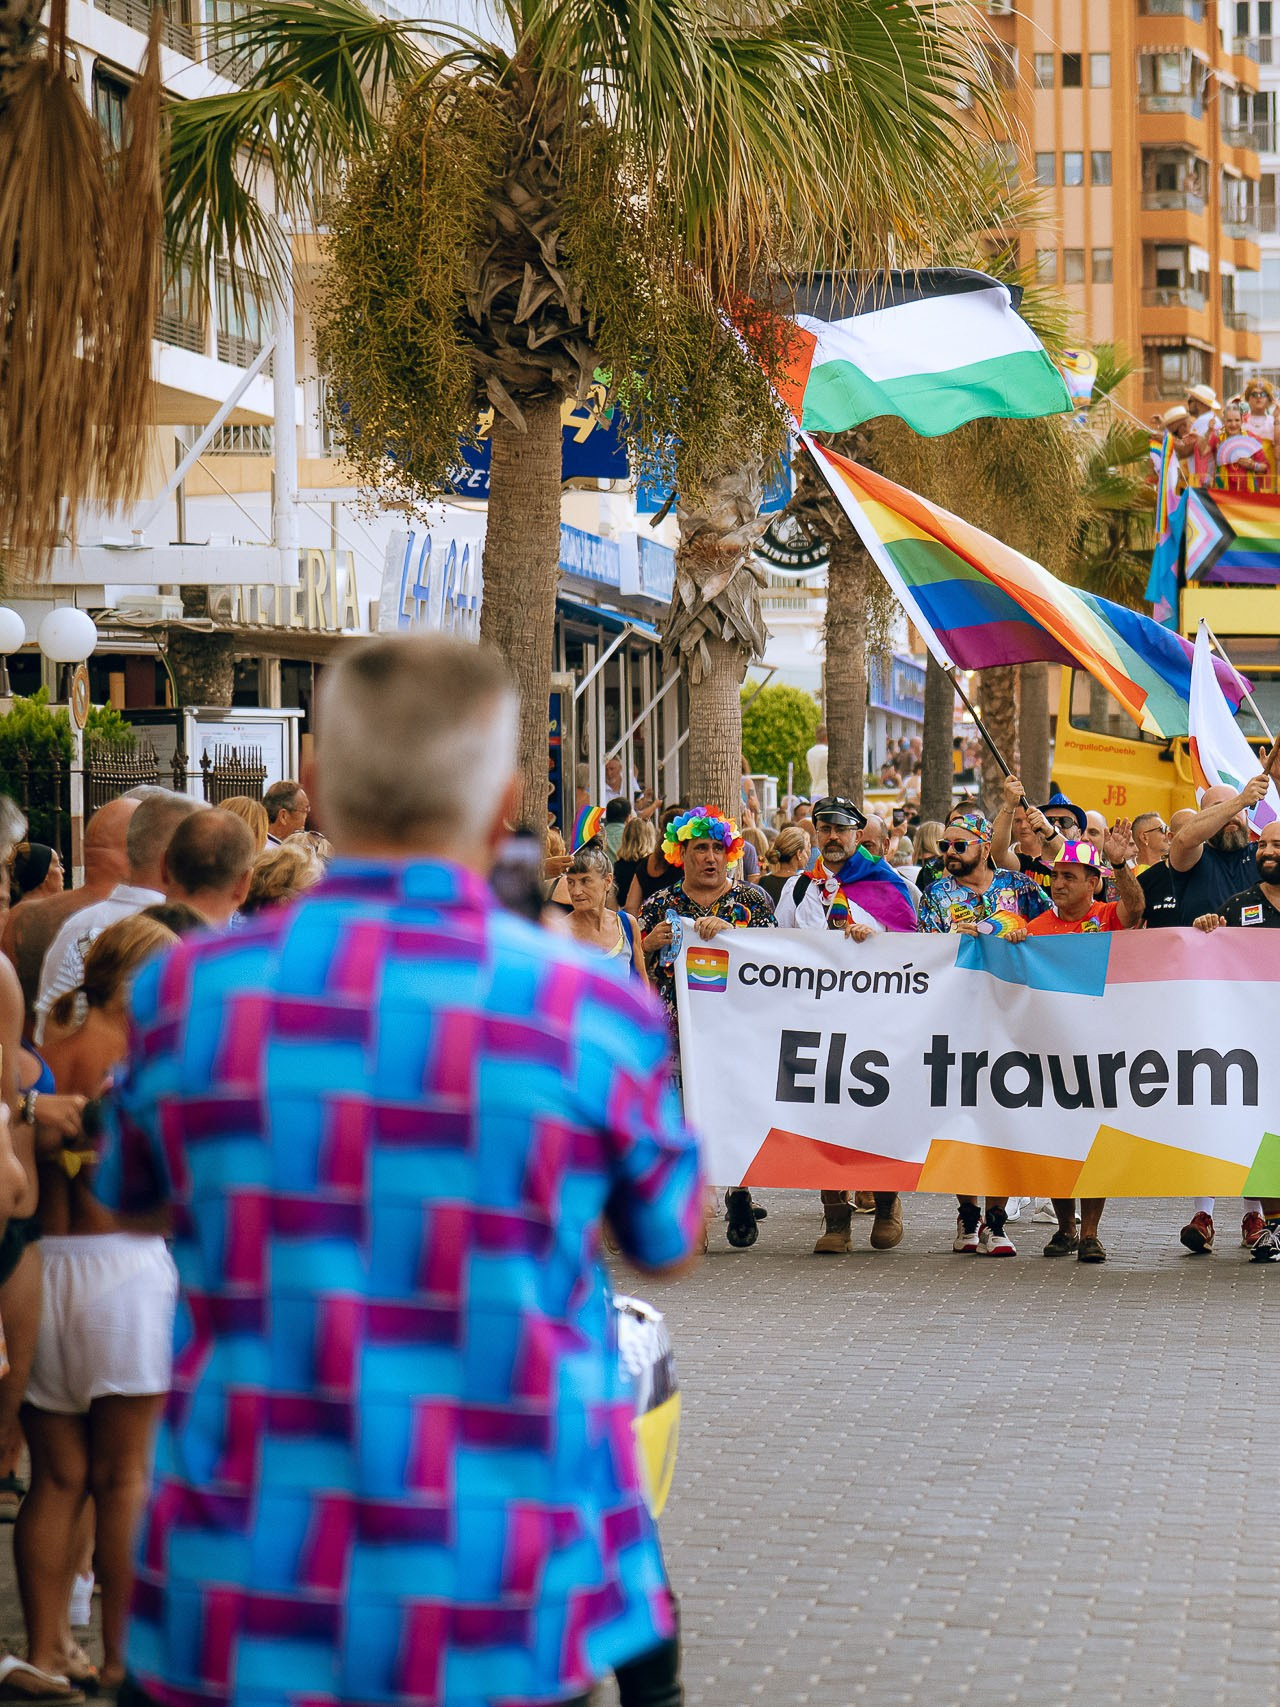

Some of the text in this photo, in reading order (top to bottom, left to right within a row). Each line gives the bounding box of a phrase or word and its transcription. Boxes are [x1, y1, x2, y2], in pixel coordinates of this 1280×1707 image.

[738, 962, 930, 1000] compromís
[775, 1029, 890, 1108] Els
[923, 1034, 1259, 1110] traurem
